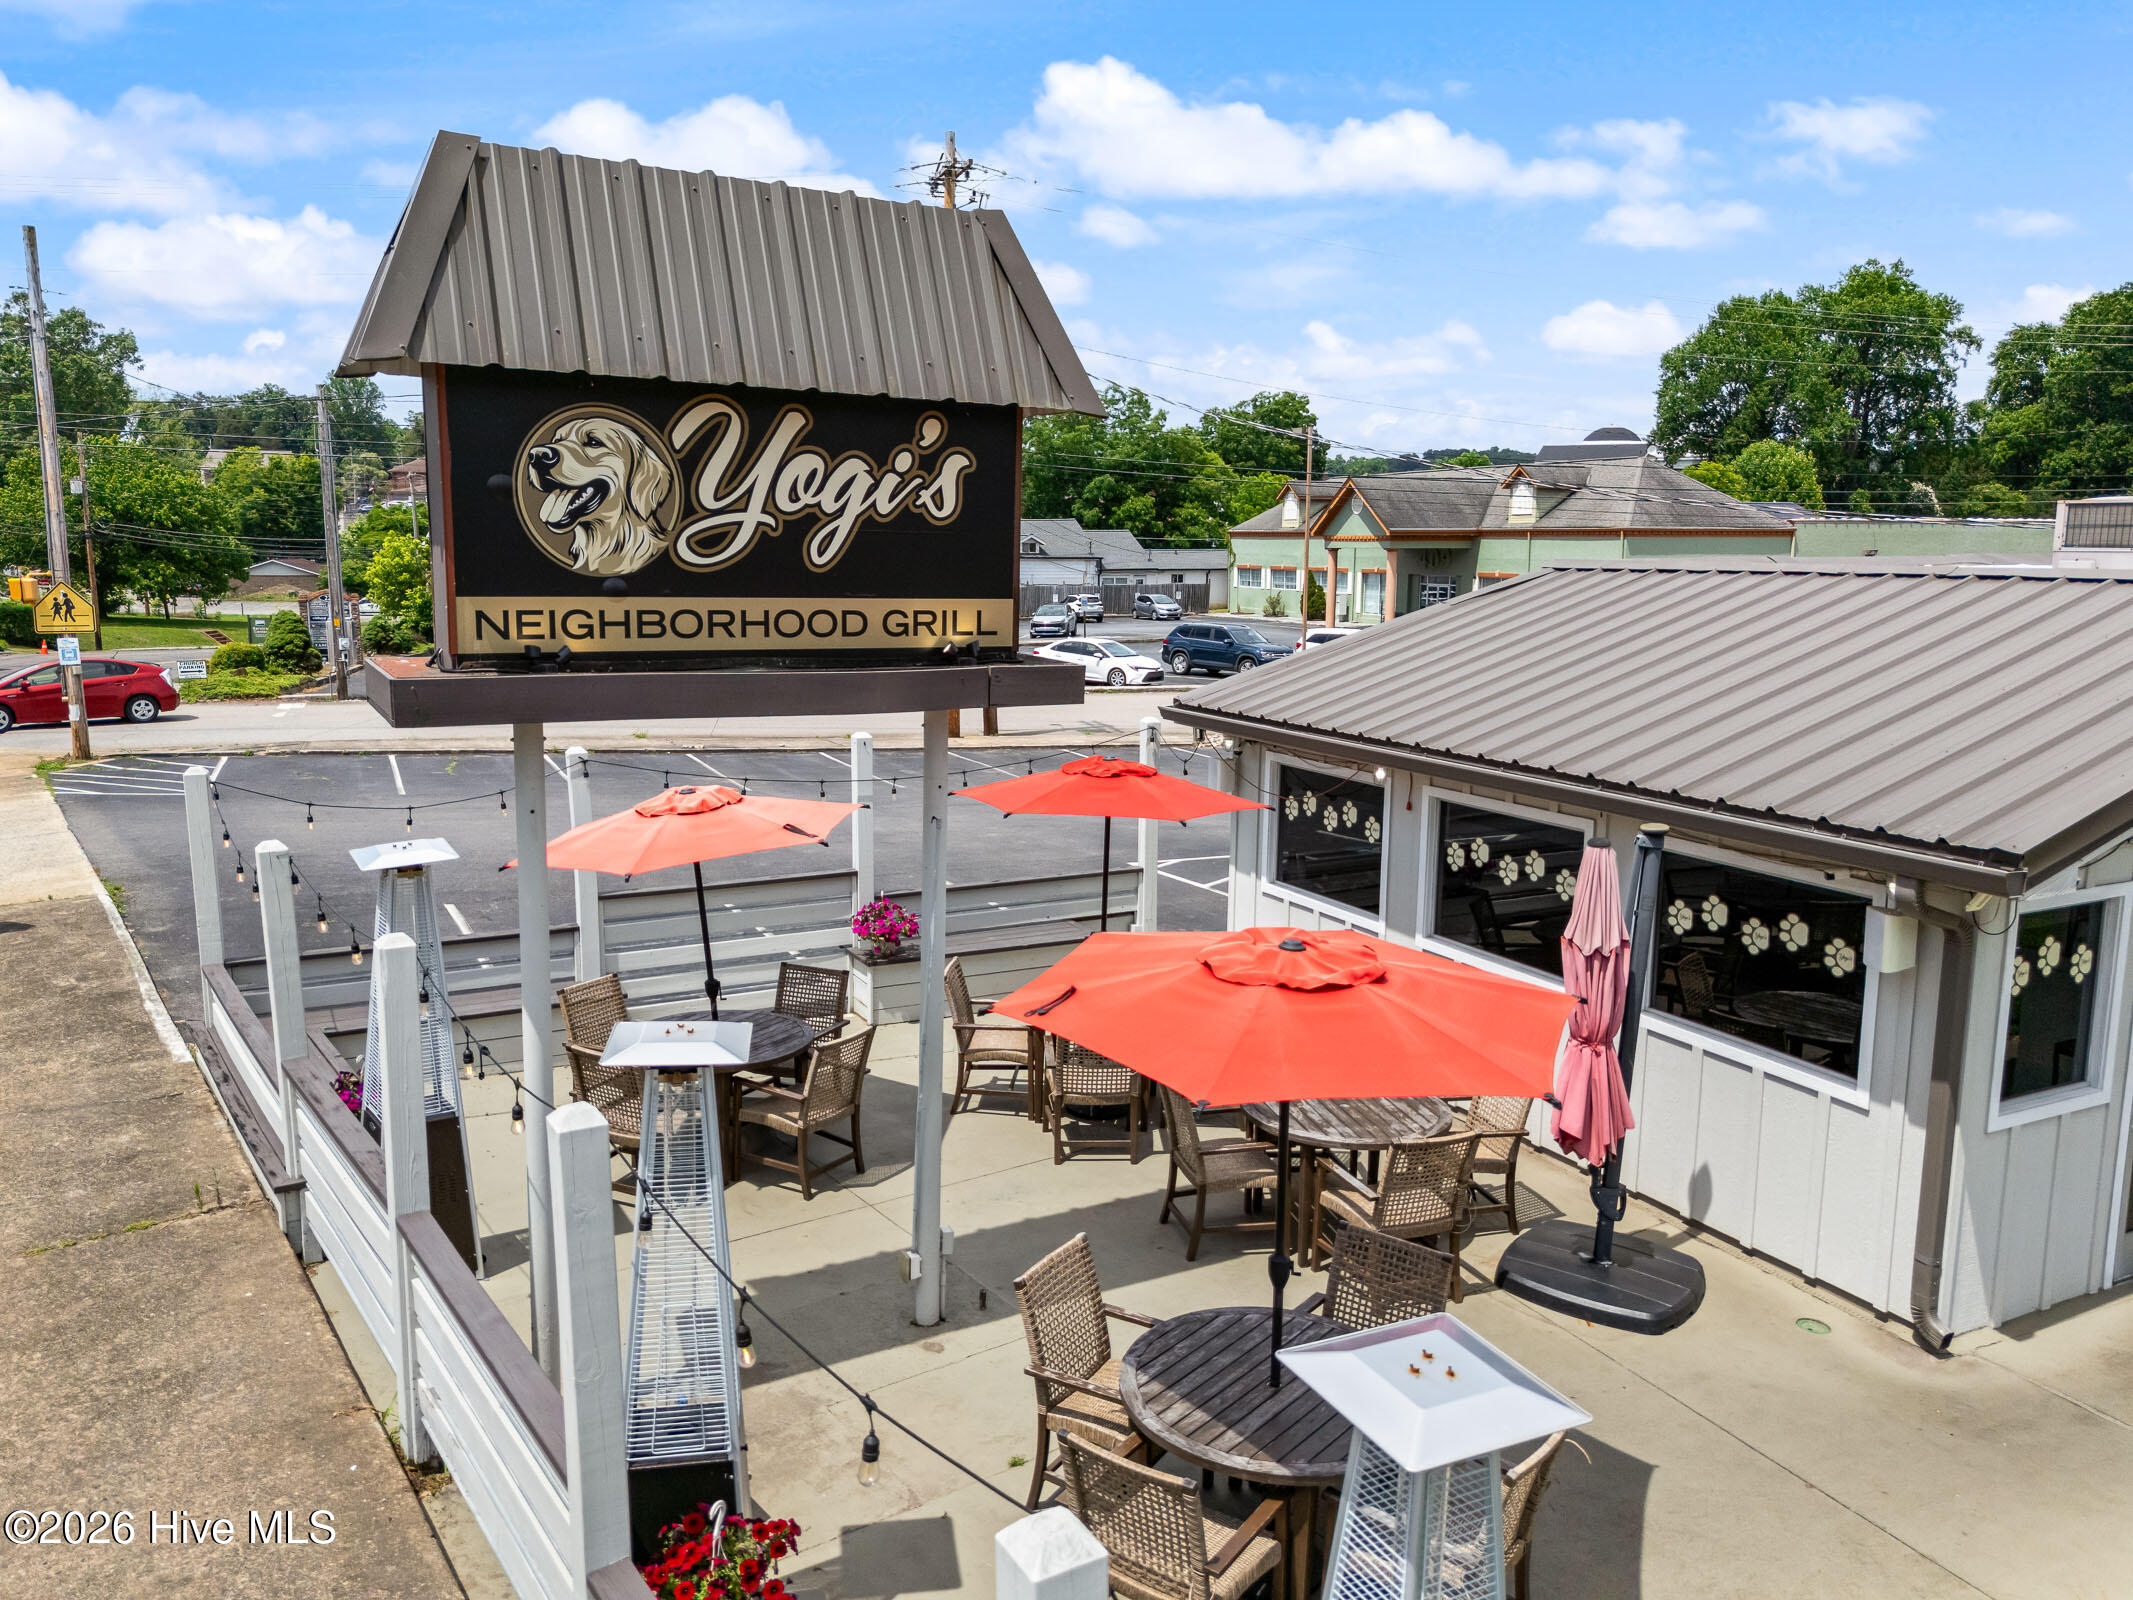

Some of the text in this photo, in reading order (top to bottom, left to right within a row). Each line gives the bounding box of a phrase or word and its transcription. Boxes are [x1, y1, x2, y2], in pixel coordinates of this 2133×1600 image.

[669, 399, 973, 568] Yogi's
[474, 608, 998, 641] NEIGHBORHOOD GRILL
